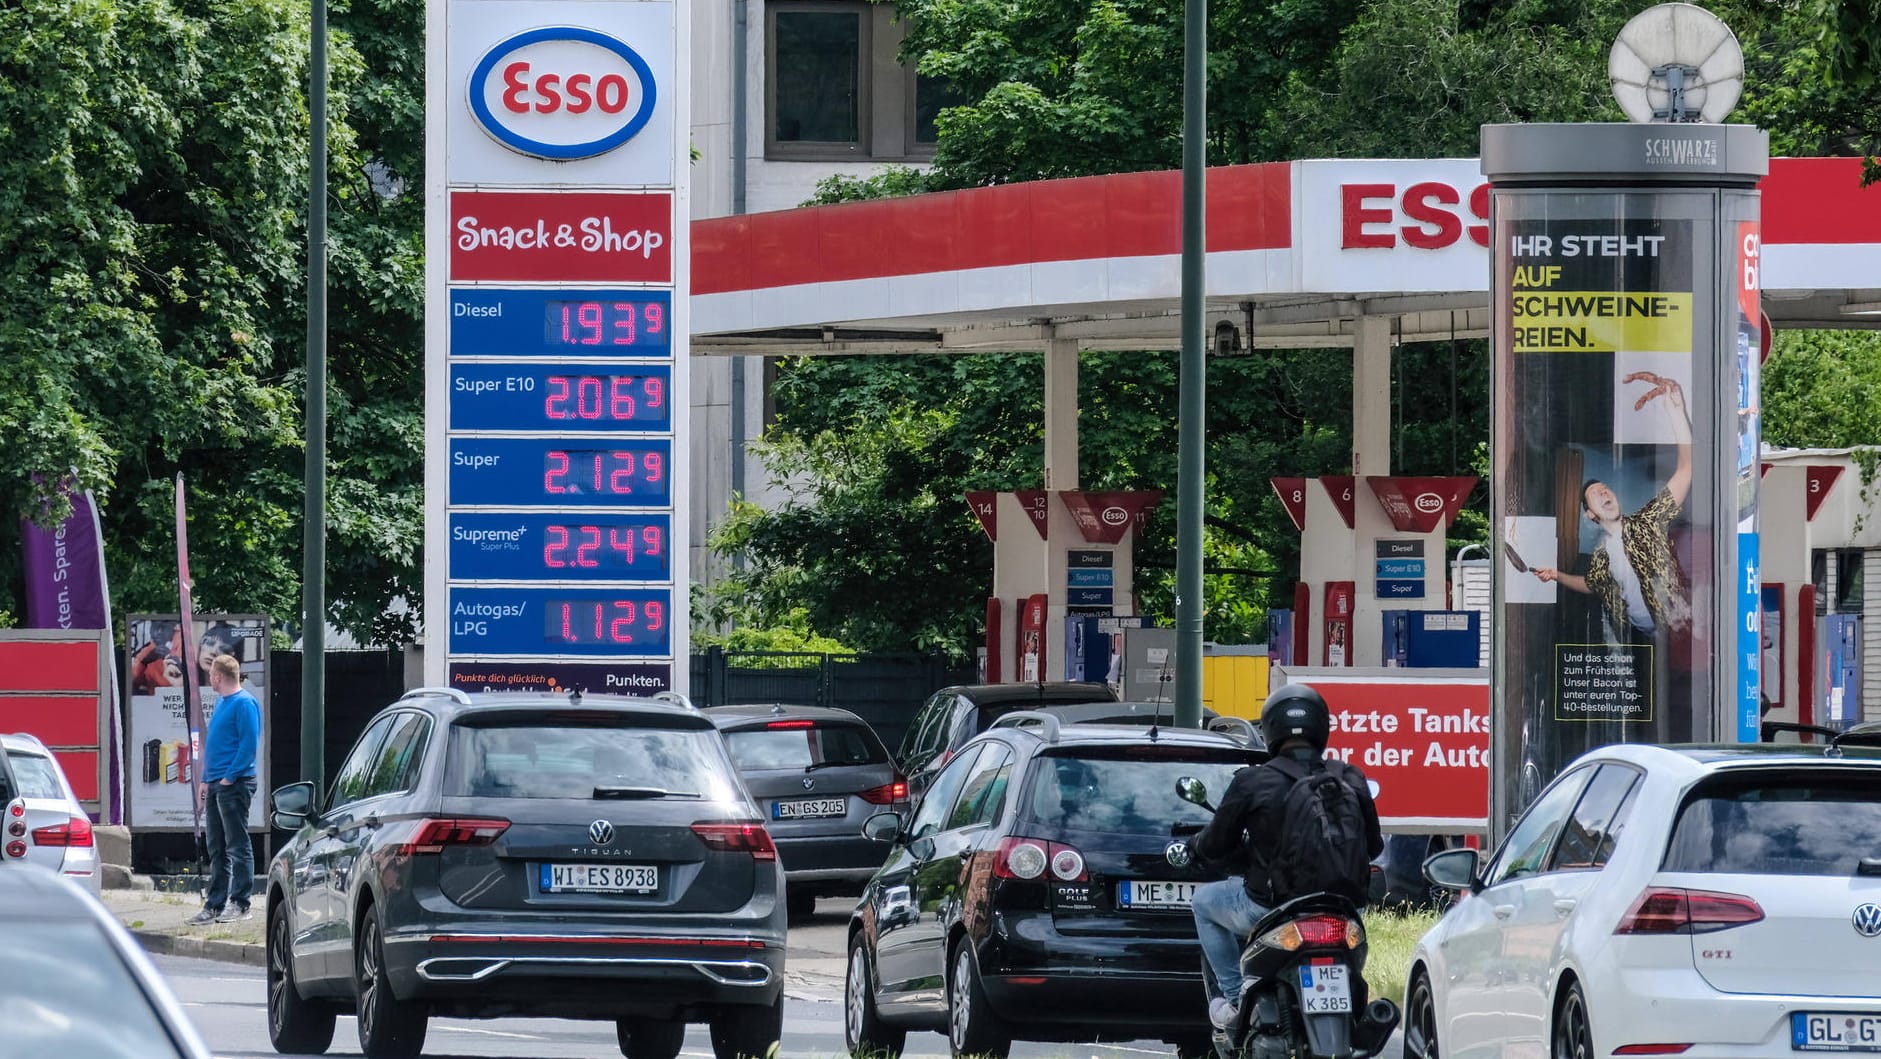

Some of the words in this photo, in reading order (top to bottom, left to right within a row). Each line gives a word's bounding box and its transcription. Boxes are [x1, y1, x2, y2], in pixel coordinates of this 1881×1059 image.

[502, 61, 629, 114] Esso
[1645, 138, 1711, 163] SCHWARZ
[1512, 235, 1553, 257] IHR
[1561, 234, 1666, 257] STEHT
[1512, 265, 1562, 288] AUF
[454, 302, 502, 317] Diesel
[1513, 296, 1680, 318] SCHWEINE-
[1513, 326, 1595, 348] REIEN.
[455, 377, 502, 395] Super
[506, 376, 535, 392] E10
[545, 376, 661, 420] 2.069
[454, 451, 500, 469] Super
[544, 451, 661, 494] 2.129
[1810, 479, 1820, 493] 3
[1292, 490, 1302, 503] 8
[1342, 487, 1351, 501] 6
[977, 503, 993, 515] 14
[1033, 497, 1046, 508] 12
[1419, 498, 1440, 507] Esso
[1033, 510, 1046, 520] 10
[1105, 511, 1125, 520] Esso
[453, 525, 527, 543] Supreme+
[544, 526, 661, 568] 2.249
[480, 542, 502, 552] Super
[503, 542, 520, 551] Plus
[1391, 544, 1414, 552] Diesel
[1081, 555, 1103, 563] Diesel
[1384, 564, 1406, 574] Super
[1406, 564, 1421, 572] E10
[1075, 572, 1095, 582] Super
[1081, 591, 1103, 601] Super
[1391, 584, 1413, 594] Super
[454, 600, 526, 618] Autogas/
[454, 621, 488, 636] LPG
[1563, 652, 1583, 663] Und
[1585, 652, 1602, 663] das
[1604, 652, 1633, 664] schon
[1563, 666, 1583, 675] zum
[454, 673, 486, 683] Punkte
[488, 673, 506, 683] dich
[508, 673, 546, 685] glücklich
[605, 673, 665, 687] Punkten.
[1563, 677, 1591, 688] Unser
[1593, 678, 1623, 688] Bacon
[1625, 678, 1637, 688] ist
[1563, 691, 1587, 700] unter
[1589, 691, 1617, 700] euren
[1619, 690, 1643, 702] Top-
[1563, 701, 1643, 715] 40-Bestellungen.
[1329, 709, 1398, 733] etzte
[1364, 741, 1413, 767] der
[780, 803, 796, 816] EN
[803, 801, 819, 814] GS
[822, 800, 844, 814] 205
[571, 848, 632, 856] TIGUAN
[554, 867, 574, 886] WI
[588, 867, 610, 886] ES
[614, 867, 656, 887] 8938
[1137, 883, 1162, 902] ME
[1702, 949, 1733, 959] GTI
[1319, 967, 1340, 981] ME
[1306, 997, 1317, 1011] K
[1320, 997, 1348, 1010] 385
[1809, 1017, 1842, 1042] GL
